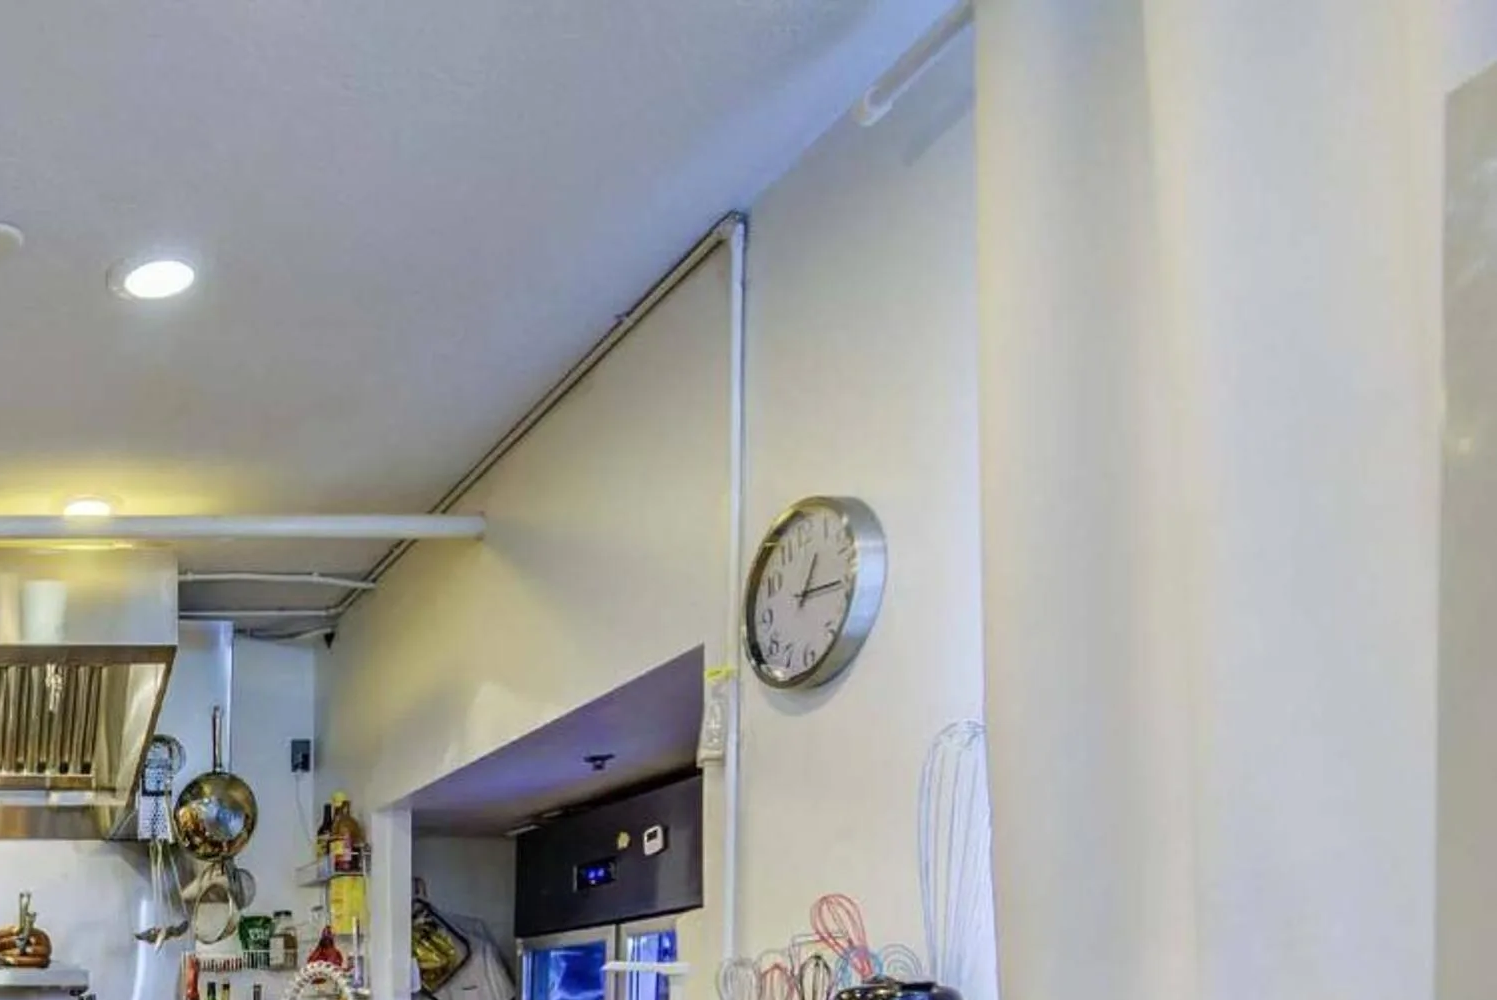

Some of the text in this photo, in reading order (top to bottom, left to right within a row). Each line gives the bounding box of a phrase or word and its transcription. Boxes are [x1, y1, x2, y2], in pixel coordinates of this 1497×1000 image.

[781, 538, 794, 566] 11
[766, 571, 783, 598] 10
[762, 608, 774, 629] 9
